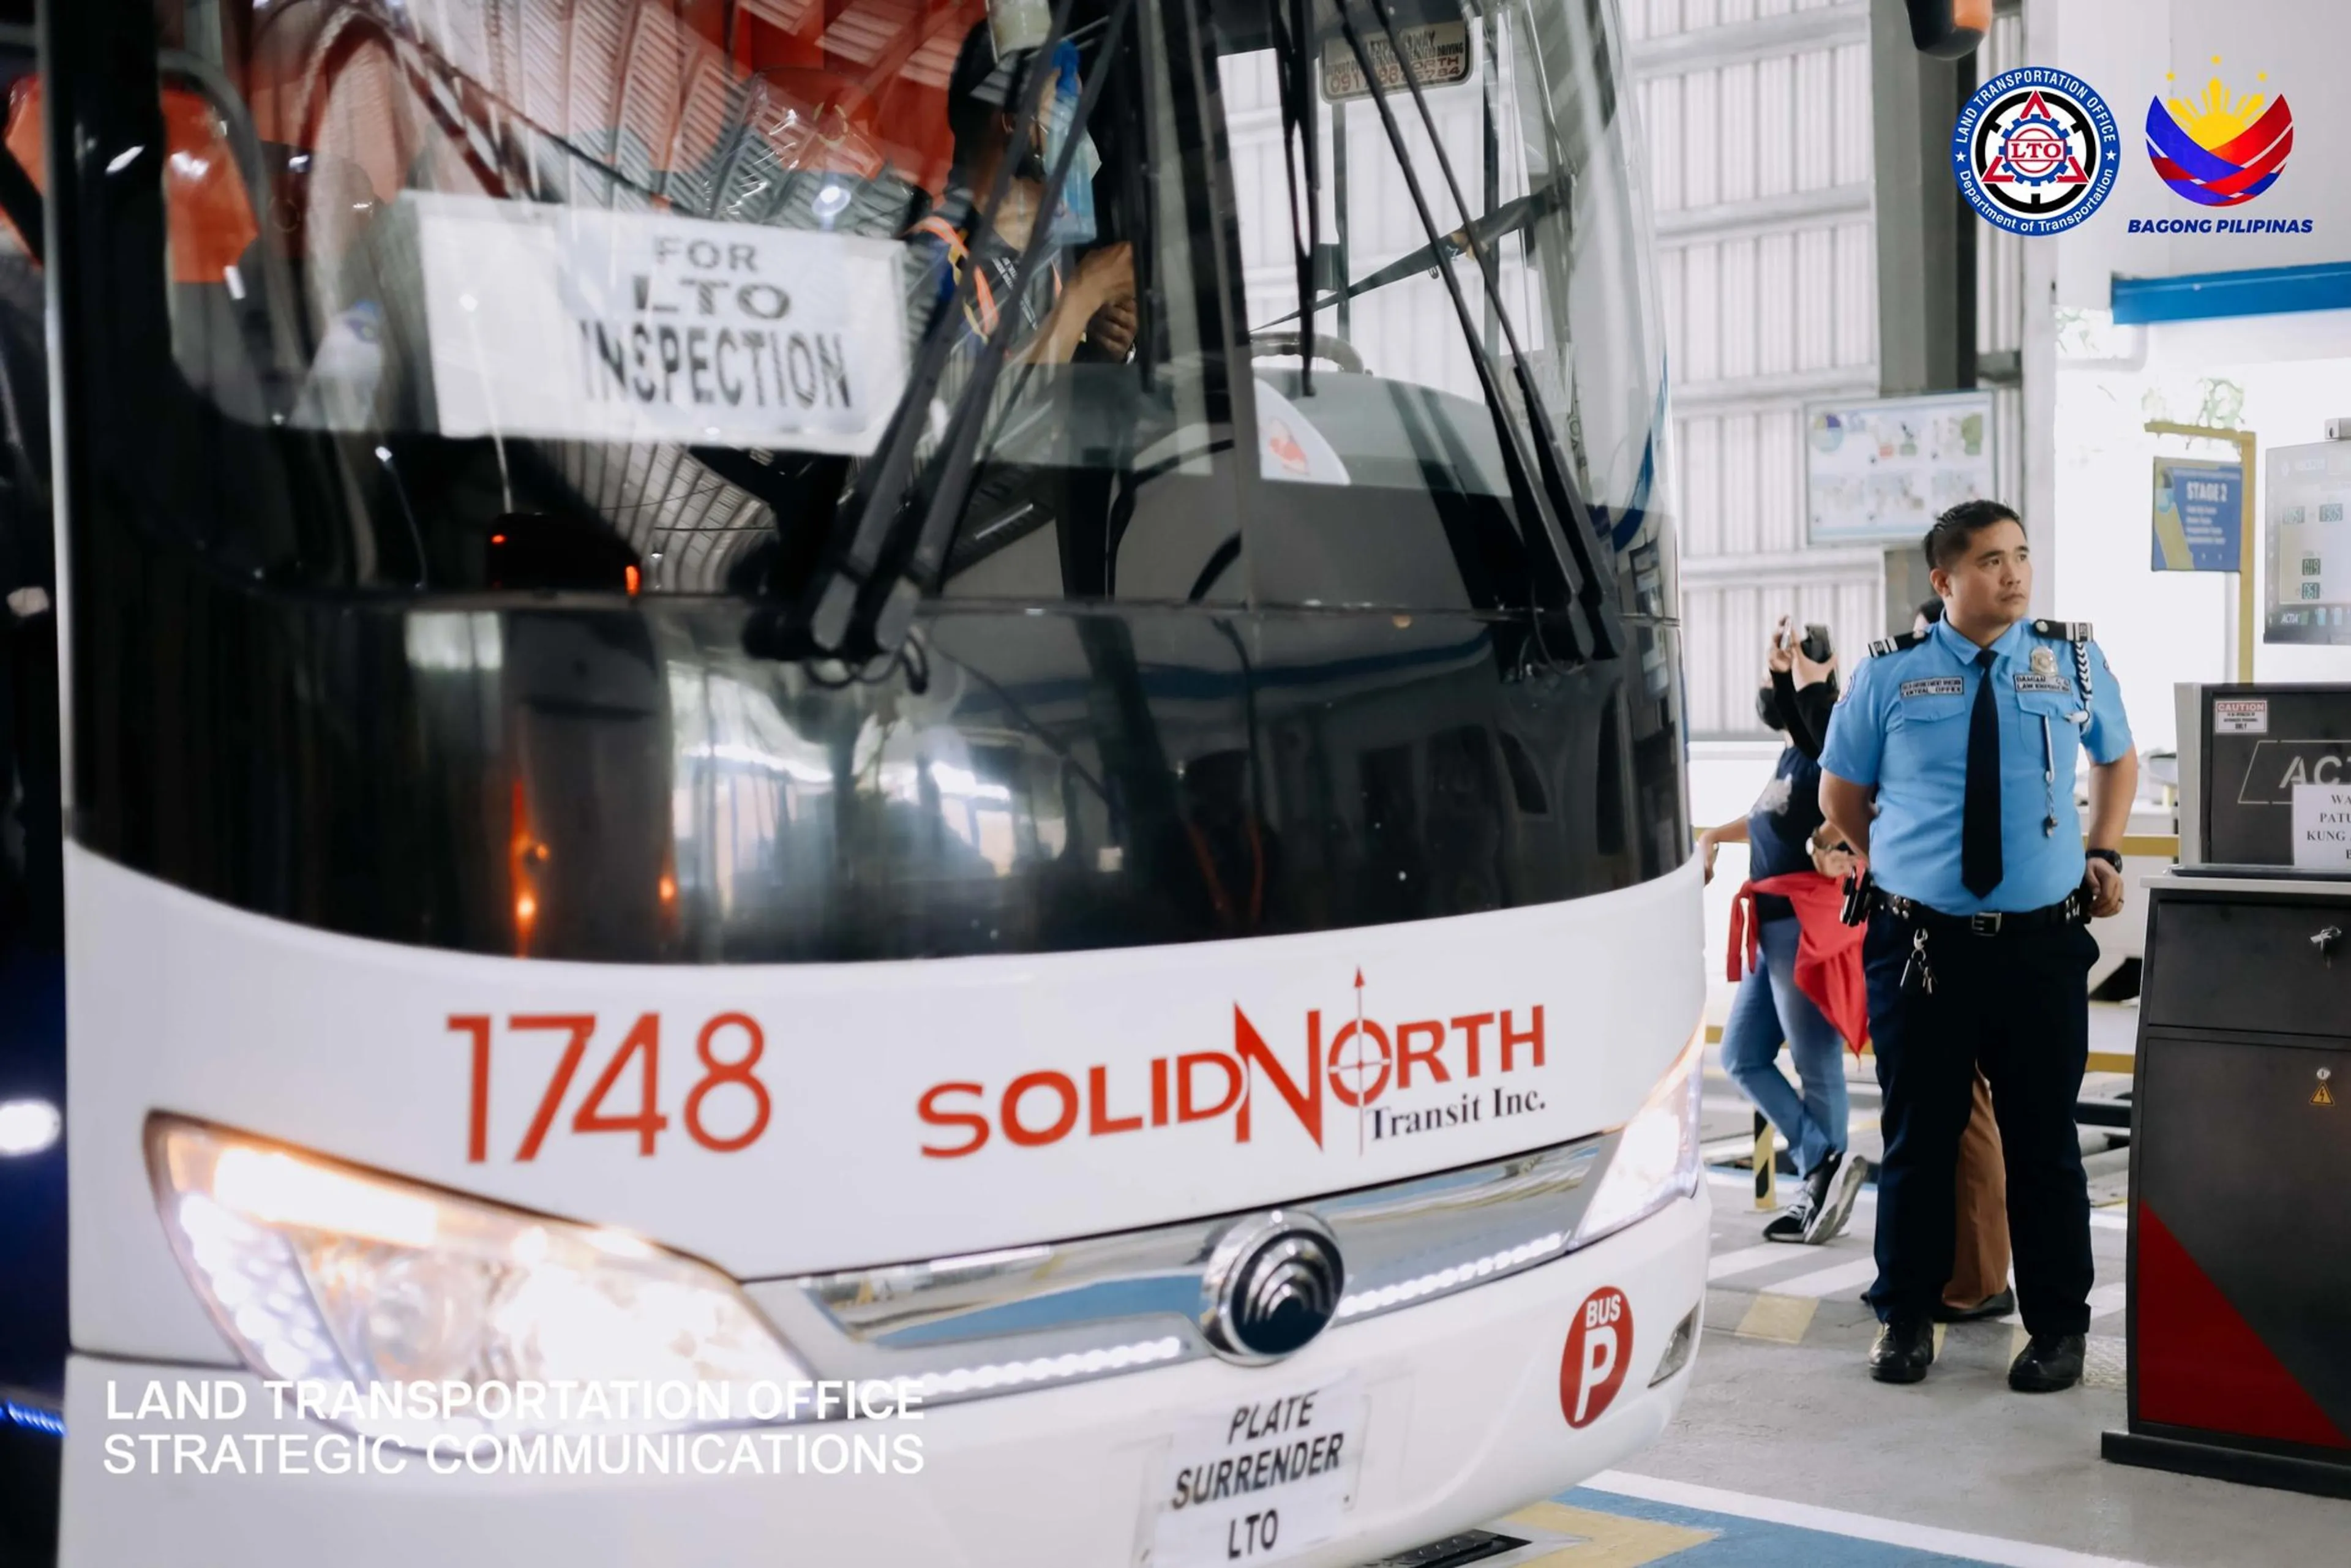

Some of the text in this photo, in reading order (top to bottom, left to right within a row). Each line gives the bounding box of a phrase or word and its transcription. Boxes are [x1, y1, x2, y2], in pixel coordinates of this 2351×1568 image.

[654, 237, 757, 272] FOR
[632, 275, 791, 320] LTO
[579, 319, 852, 409] INSPECTION
[2186, 481, 2219, 502] STAGE
[2306, 830, 2346, 841] KUNG
[447, 1011, 773, 1163] 1748
[1370, 1087, 1547, 1141] Transit Inc.
[1585, 1294, 1621, 1329] BUS
[1573, 1324, 1618, 1424] P
[1227, 1390, 1319, 1444] PLATE
[1171, 1432, 1344, 1510] SURRENDER
[1227, 1509, 1279, 1559] LTO
